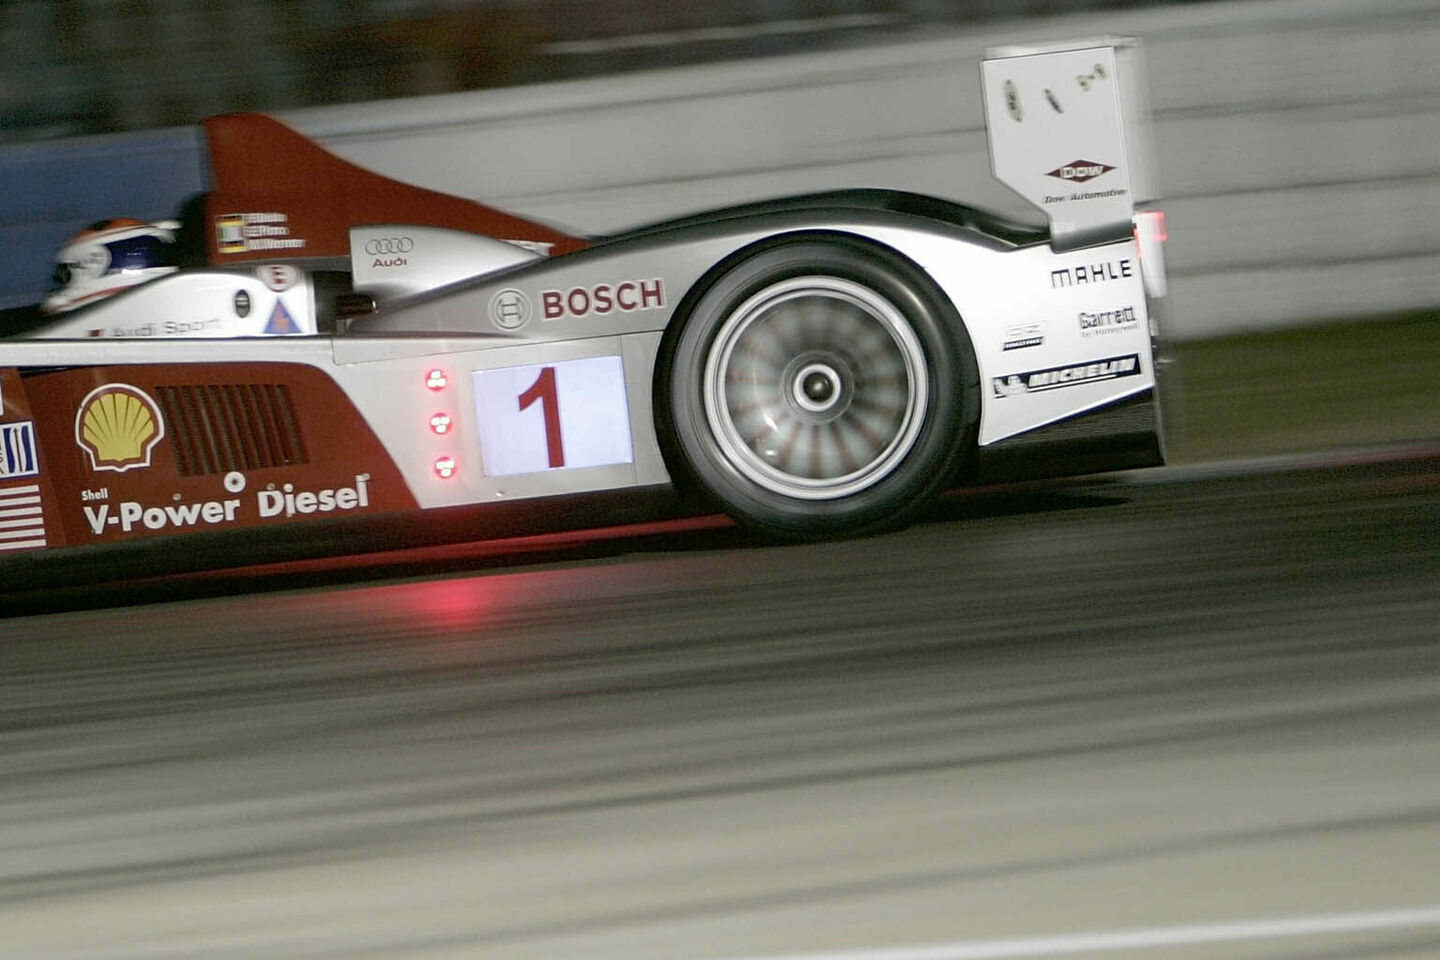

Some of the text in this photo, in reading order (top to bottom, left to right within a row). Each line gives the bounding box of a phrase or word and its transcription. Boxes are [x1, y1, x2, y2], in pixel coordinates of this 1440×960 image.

[372, 257, 408, 268] Audi
[1051, 260, 1133, 288] MAHLE
[542, 279, 663, 319] BOSCH
[1080, 307, 1137, 329] Garrett
[518, 367, 564, 468] 1
[81, 487, 108, 501] Shell
[83, 474, 369, 535] V-Power Diesel
